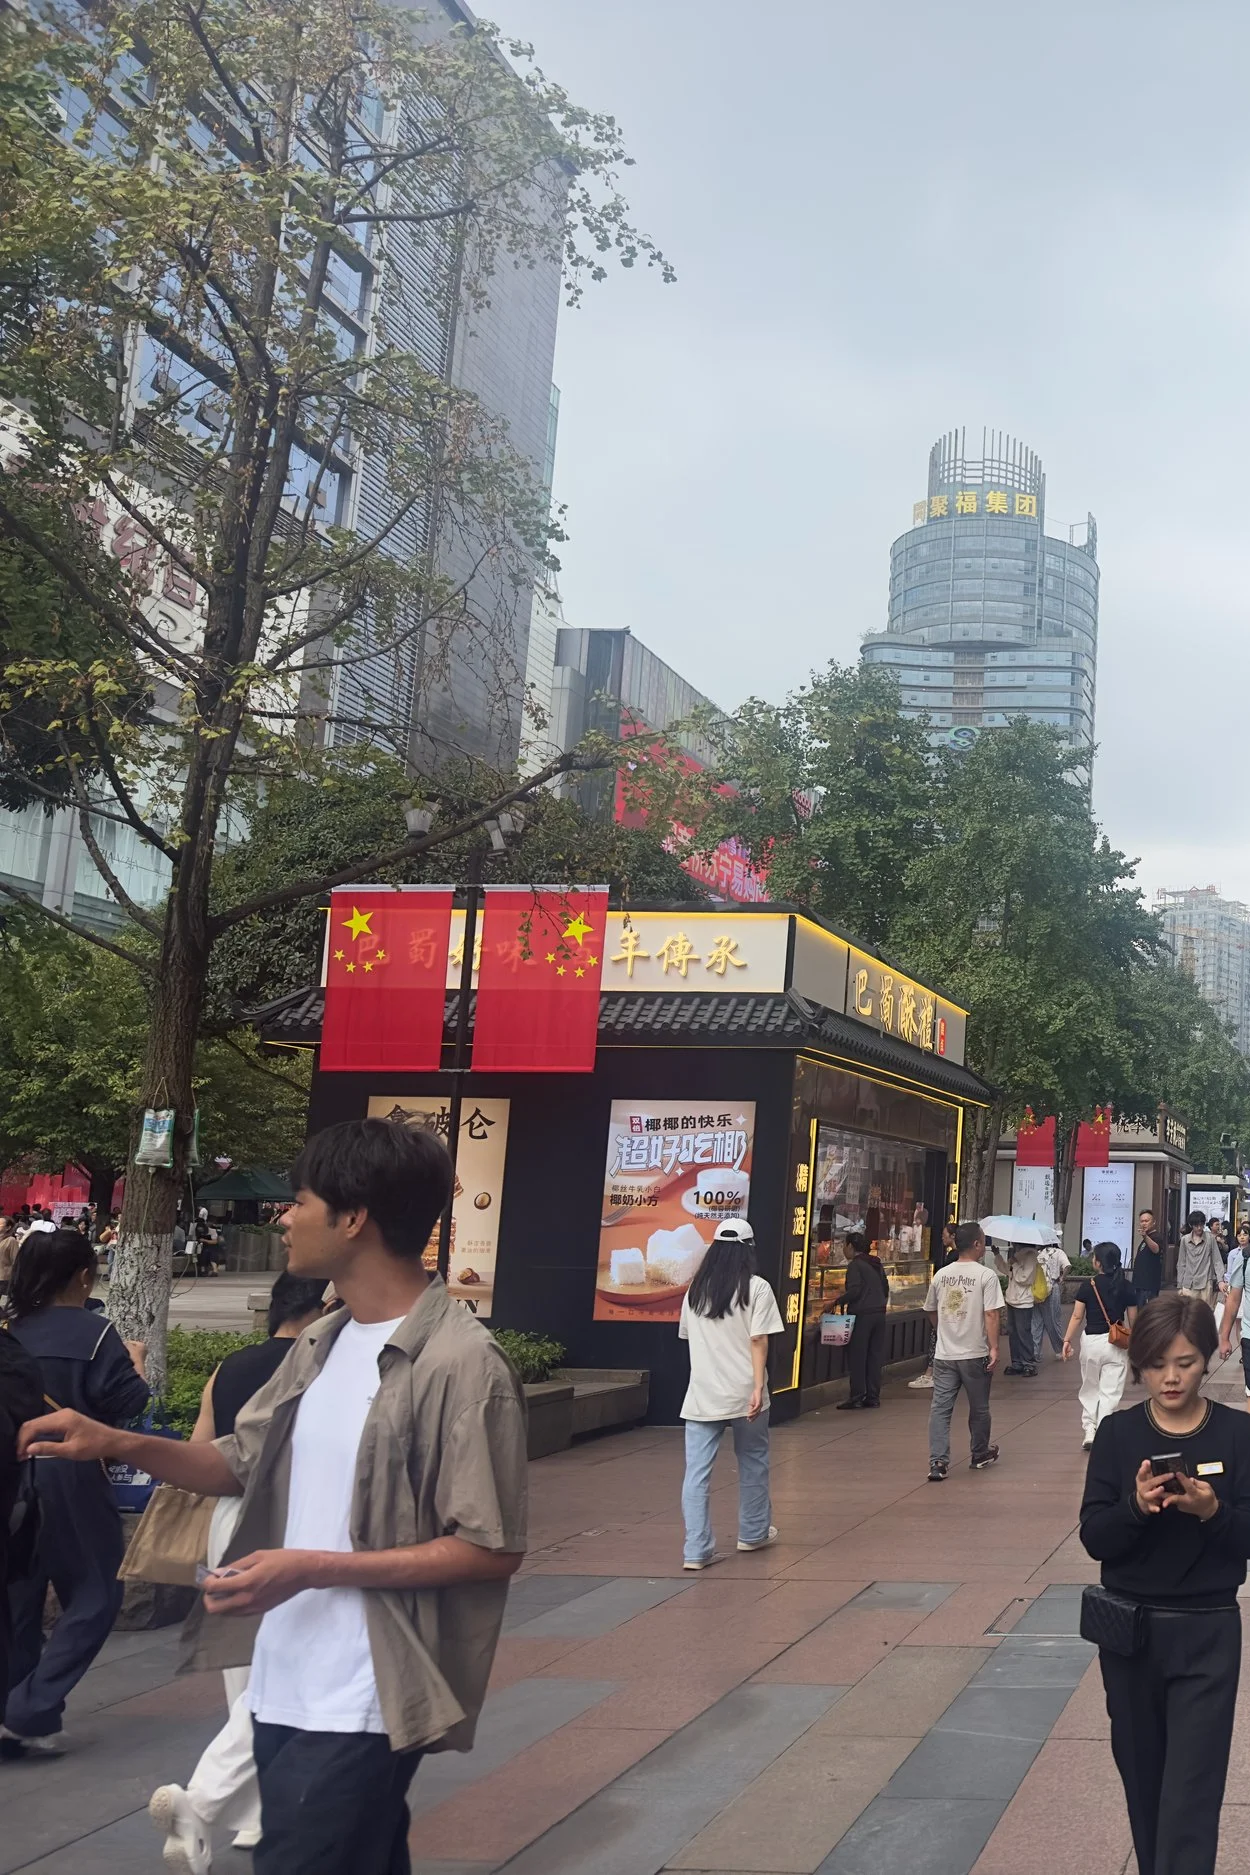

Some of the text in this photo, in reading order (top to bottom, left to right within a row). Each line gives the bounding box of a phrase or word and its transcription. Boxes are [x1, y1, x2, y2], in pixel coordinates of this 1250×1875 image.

[929, 490, 1038, 517] 聚福集团
[644, 1113, 733, 1132] 椰椰的快乐
[609, 1130, 749, 1178] 超好吃椰
[609, 1193, 659, 1207] 椰奶小方
[693, 1191, 741, 1206] 100%
[941, 1274, 976, 1287] Harry Potter
